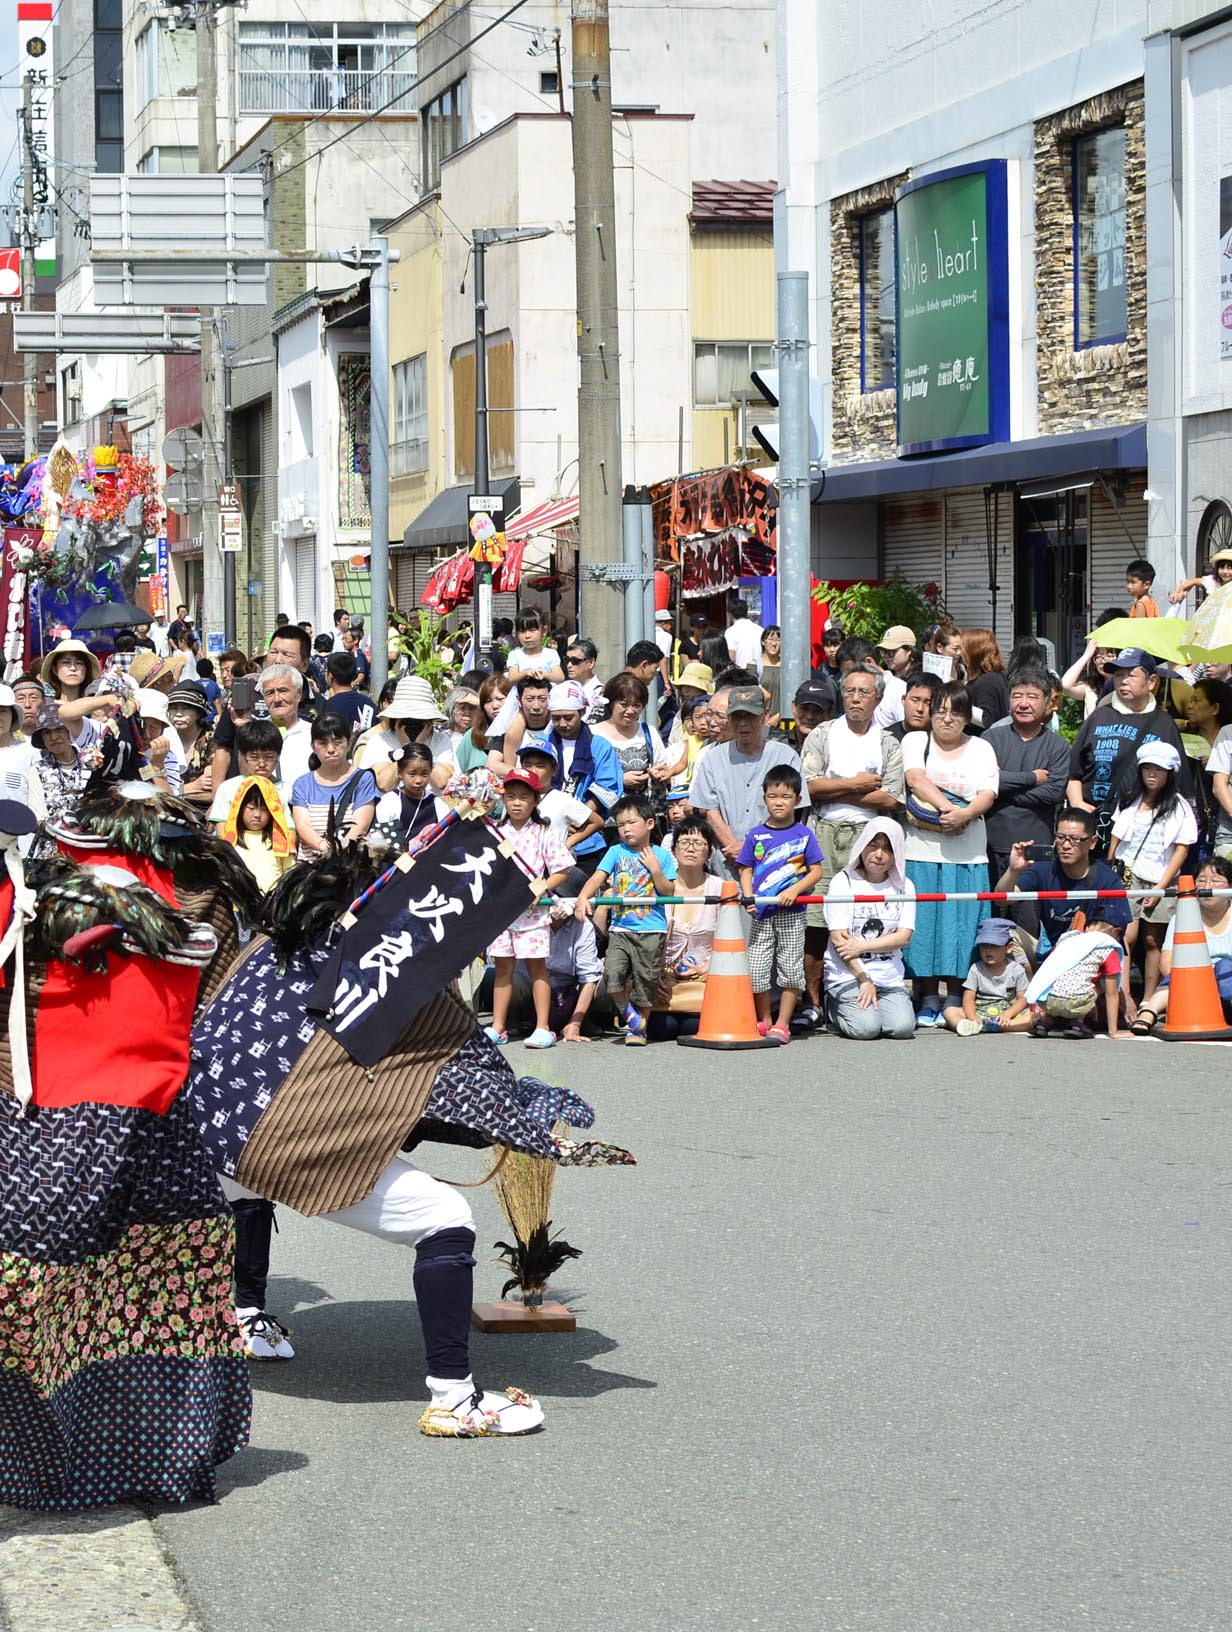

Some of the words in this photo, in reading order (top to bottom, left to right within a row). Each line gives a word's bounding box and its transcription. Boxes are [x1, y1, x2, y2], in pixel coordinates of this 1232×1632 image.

[902, 236, 928, 295] style
[934, 219, 978, 279] heart
[1094, 724, 1119, 736] WHAT
[1116, 723, 1139, 737] LIES
[1096, 739, 1119, 749] 1908
